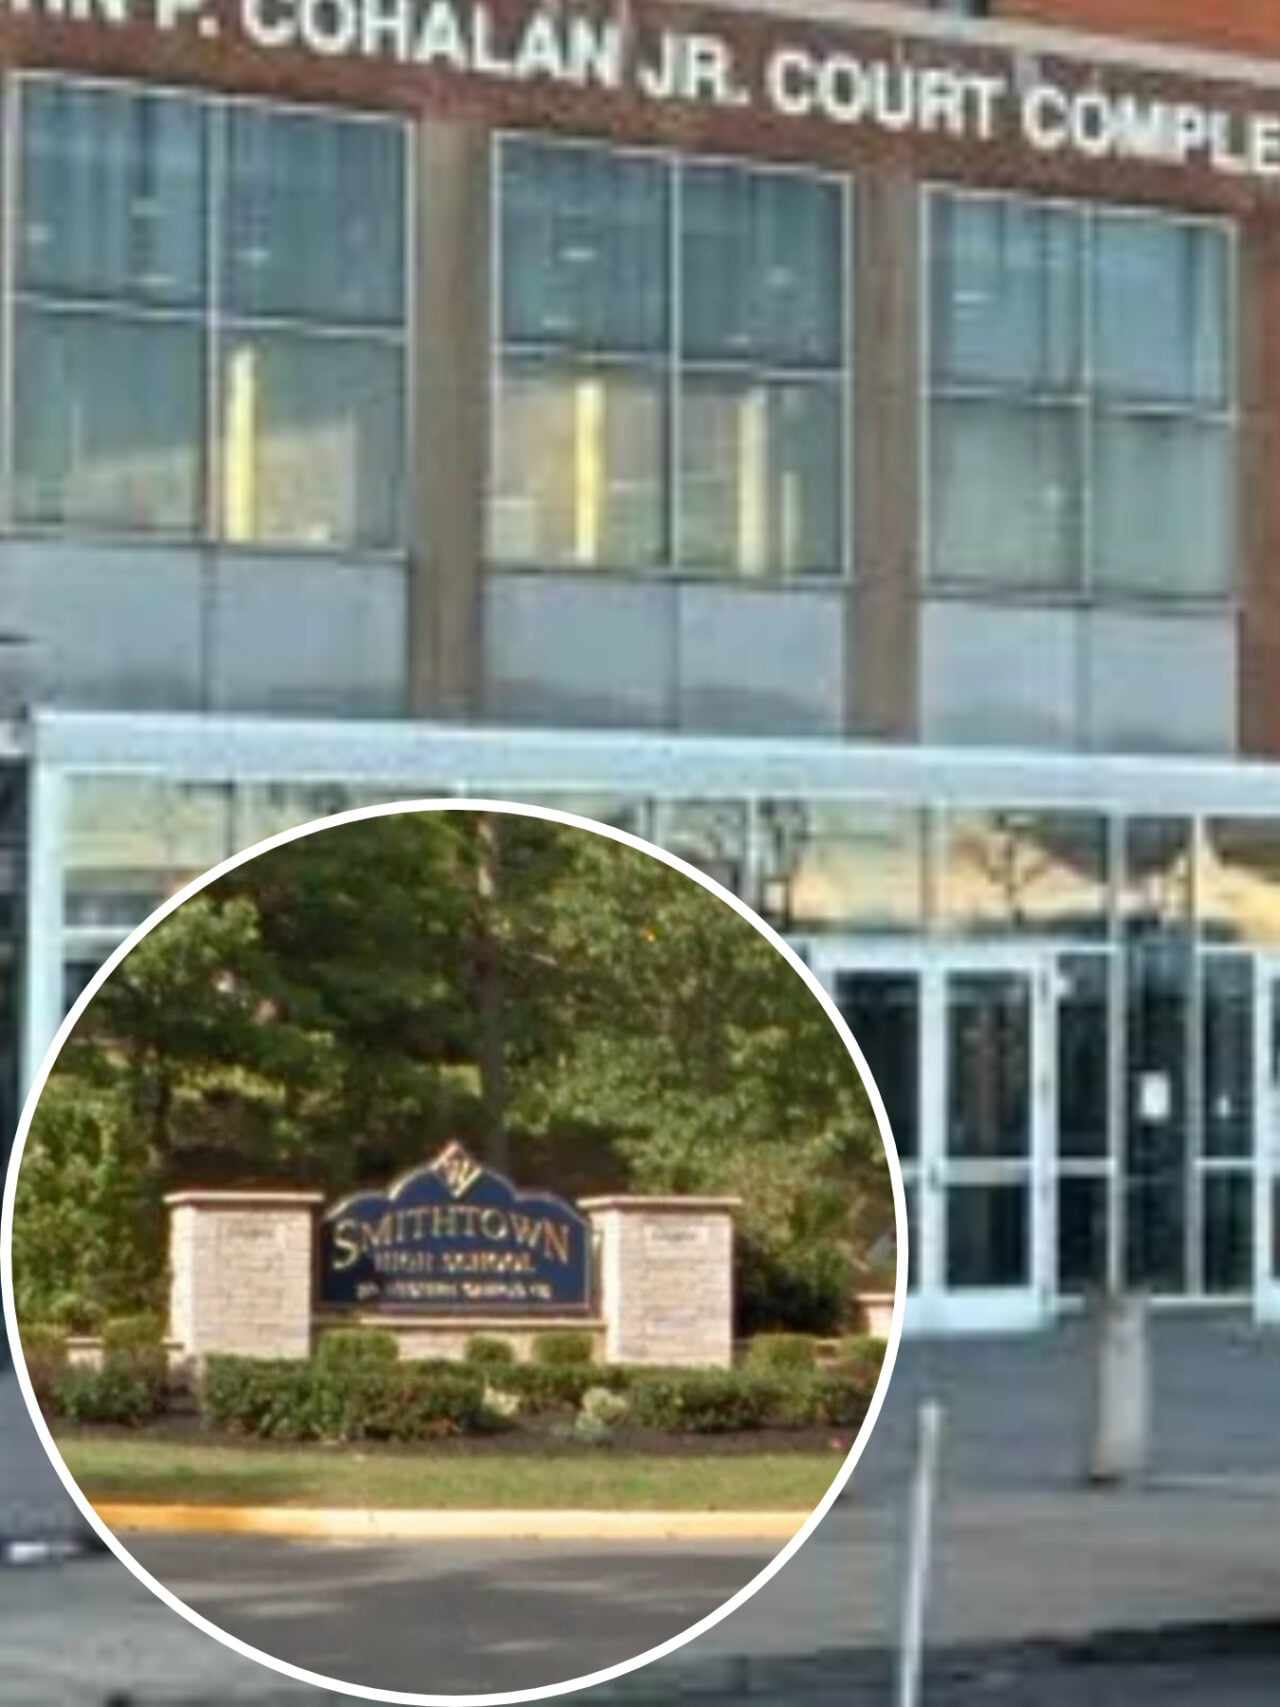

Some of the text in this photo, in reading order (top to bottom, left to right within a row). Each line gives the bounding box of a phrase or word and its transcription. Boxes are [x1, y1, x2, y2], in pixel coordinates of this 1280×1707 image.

[239, 0, 623, 89] COHALAN
[637, 33, 750, 106] JR.
[766, 52, 1007, 140] COURT
[333, 1205, 570, 1270] SMITHTOWN
